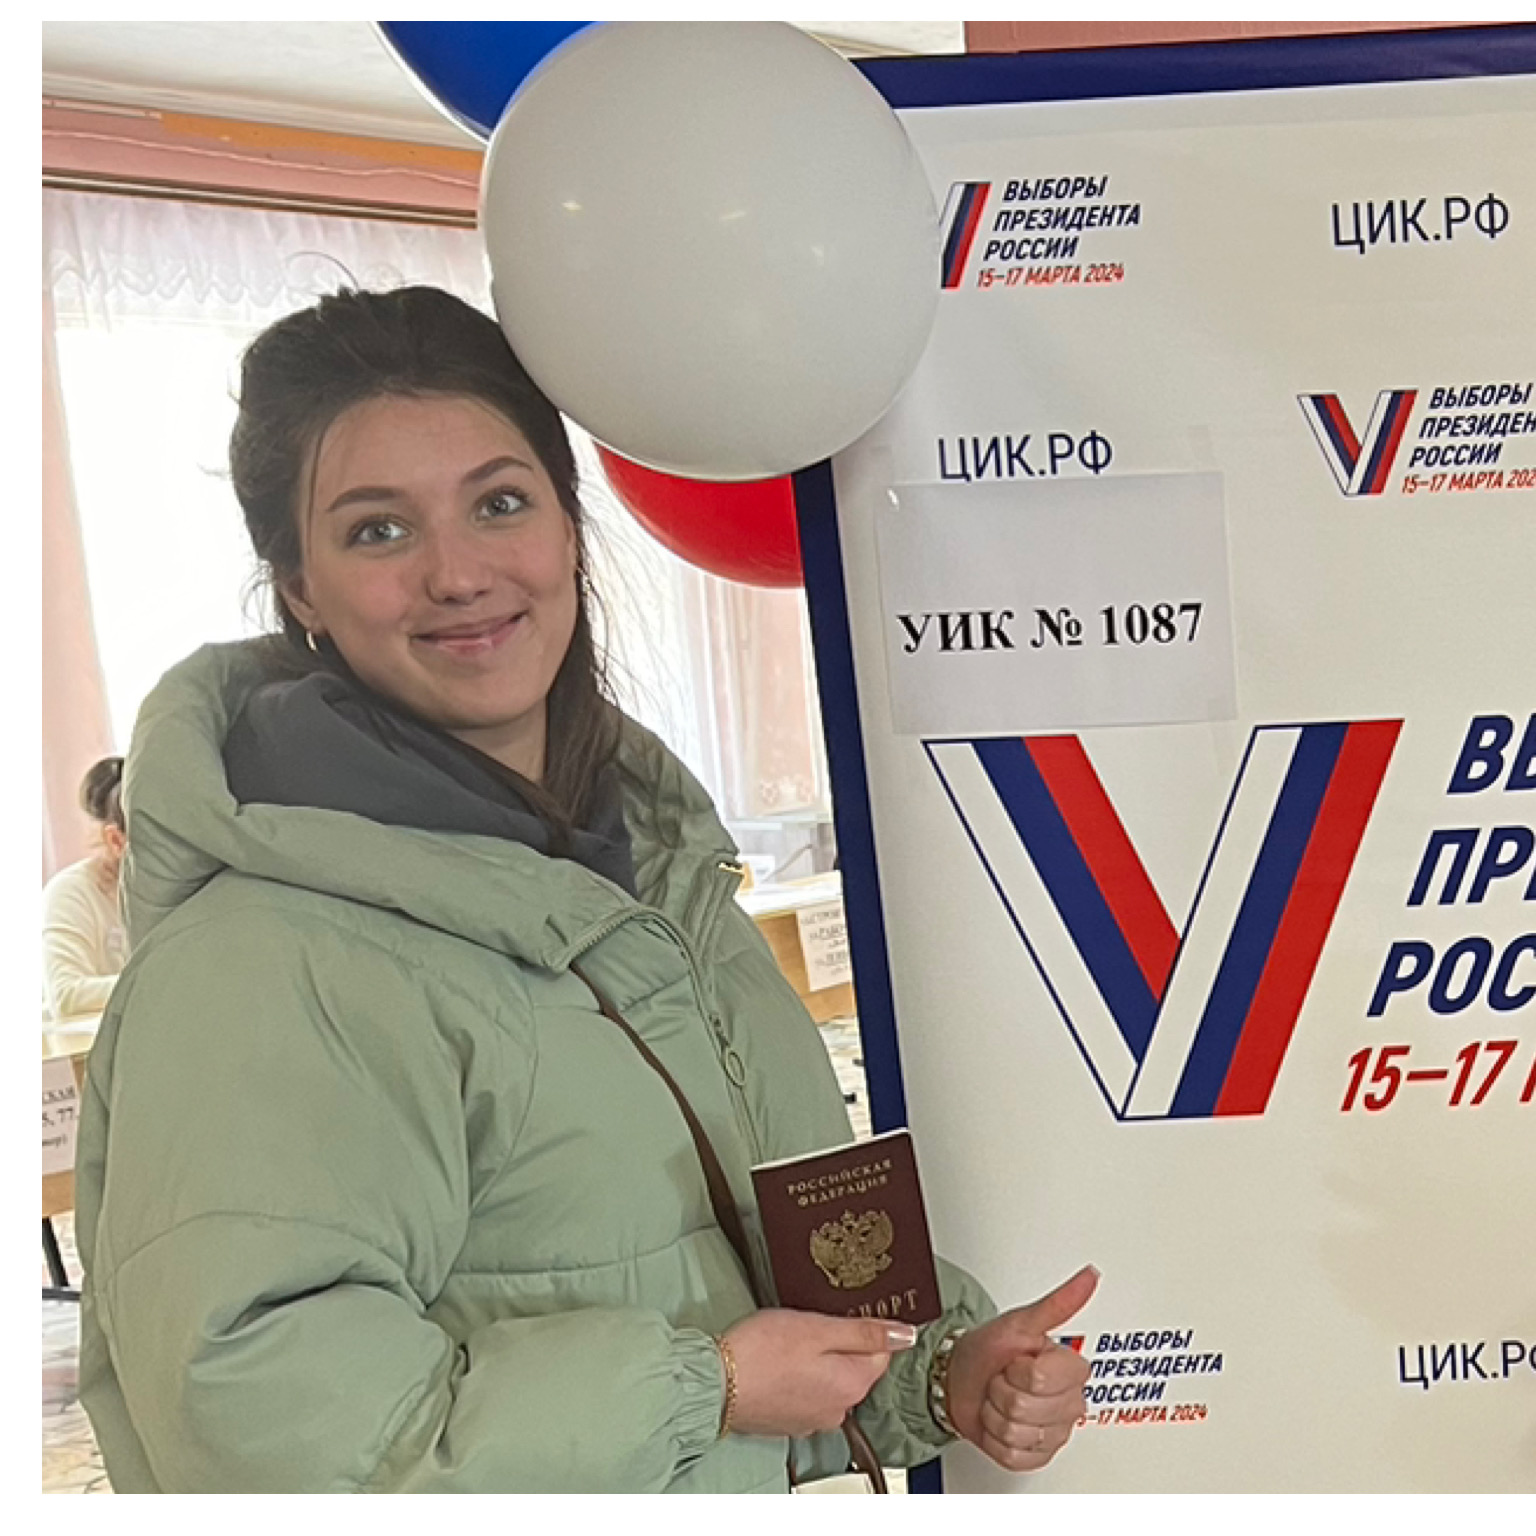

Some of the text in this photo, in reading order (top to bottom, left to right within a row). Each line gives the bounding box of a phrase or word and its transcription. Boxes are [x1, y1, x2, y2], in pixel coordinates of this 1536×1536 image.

[1002, 175, 1108, 201] ВЫБОРЫ
[993, 203, 1141, 231] ПРЕЗИДЕНТА
[1332, 193, 1509, 254] ЦИК.РФ
[984, 236, 1079, 261] РОССИИ
[1024, 265, 1082, 286] МАРТА
[1085, 263, 1124, 283] 2024
[1429, 383, 1533, 409] ВЫБОРЫ
[938, 430, 1112, 482] ЦИК.РФ
[1409, 442, 1503, 468] РОССИИ
[1449, 471, 1505, 492] МАРТА
[897, 610, 1016, 654] УИК
[1101, 602, 1202, 645] 1087
[787, 1159, 892, 1196] РОССИЙСКАЯ
[798, 1174, 888, 1207] ФЕДЕРАЦИЯ
[1096, 1329, 1193, 1353] ВЫБОРЫ
[1090, 1354, 1223, 1378] ПРЕЗИДЕНТА
[1082, 1382, 1166, 1404] РОССИИ
[1115, 1406, 1168, 1425] МАРТА
[1170, 1403, 1208, 1421] 2024
